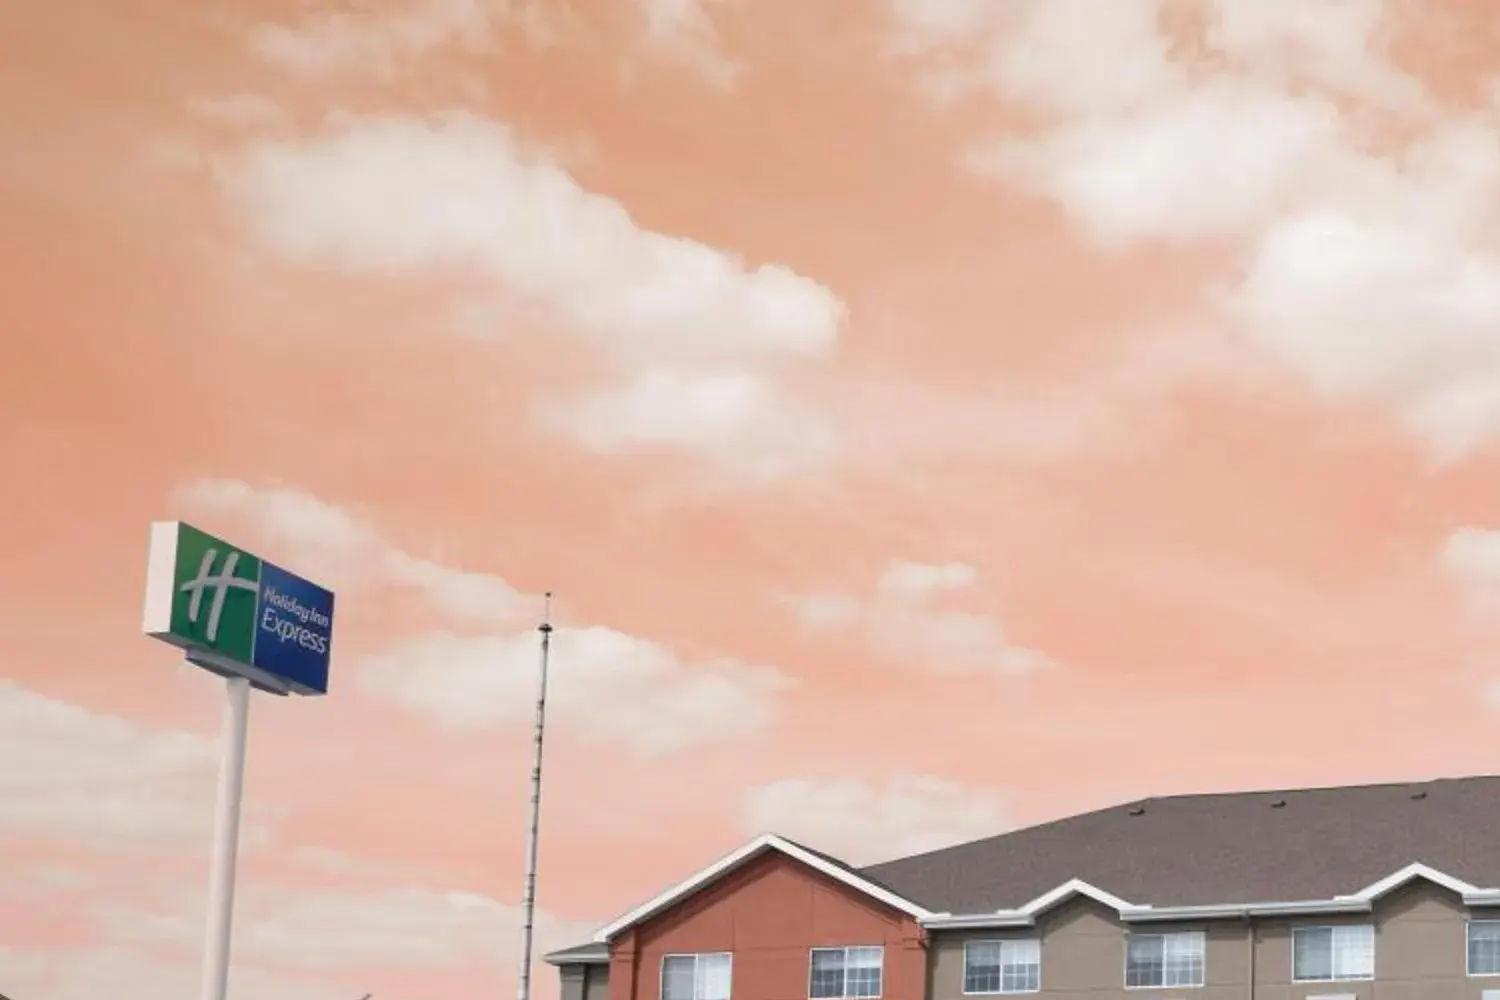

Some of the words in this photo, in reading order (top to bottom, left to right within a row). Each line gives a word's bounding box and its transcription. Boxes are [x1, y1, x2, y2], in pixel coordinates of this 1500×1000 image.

[263, 586, 310, 623] Holiday
[310, 607, 329, 627] Inn
[261, 607, 328, 655] Express
